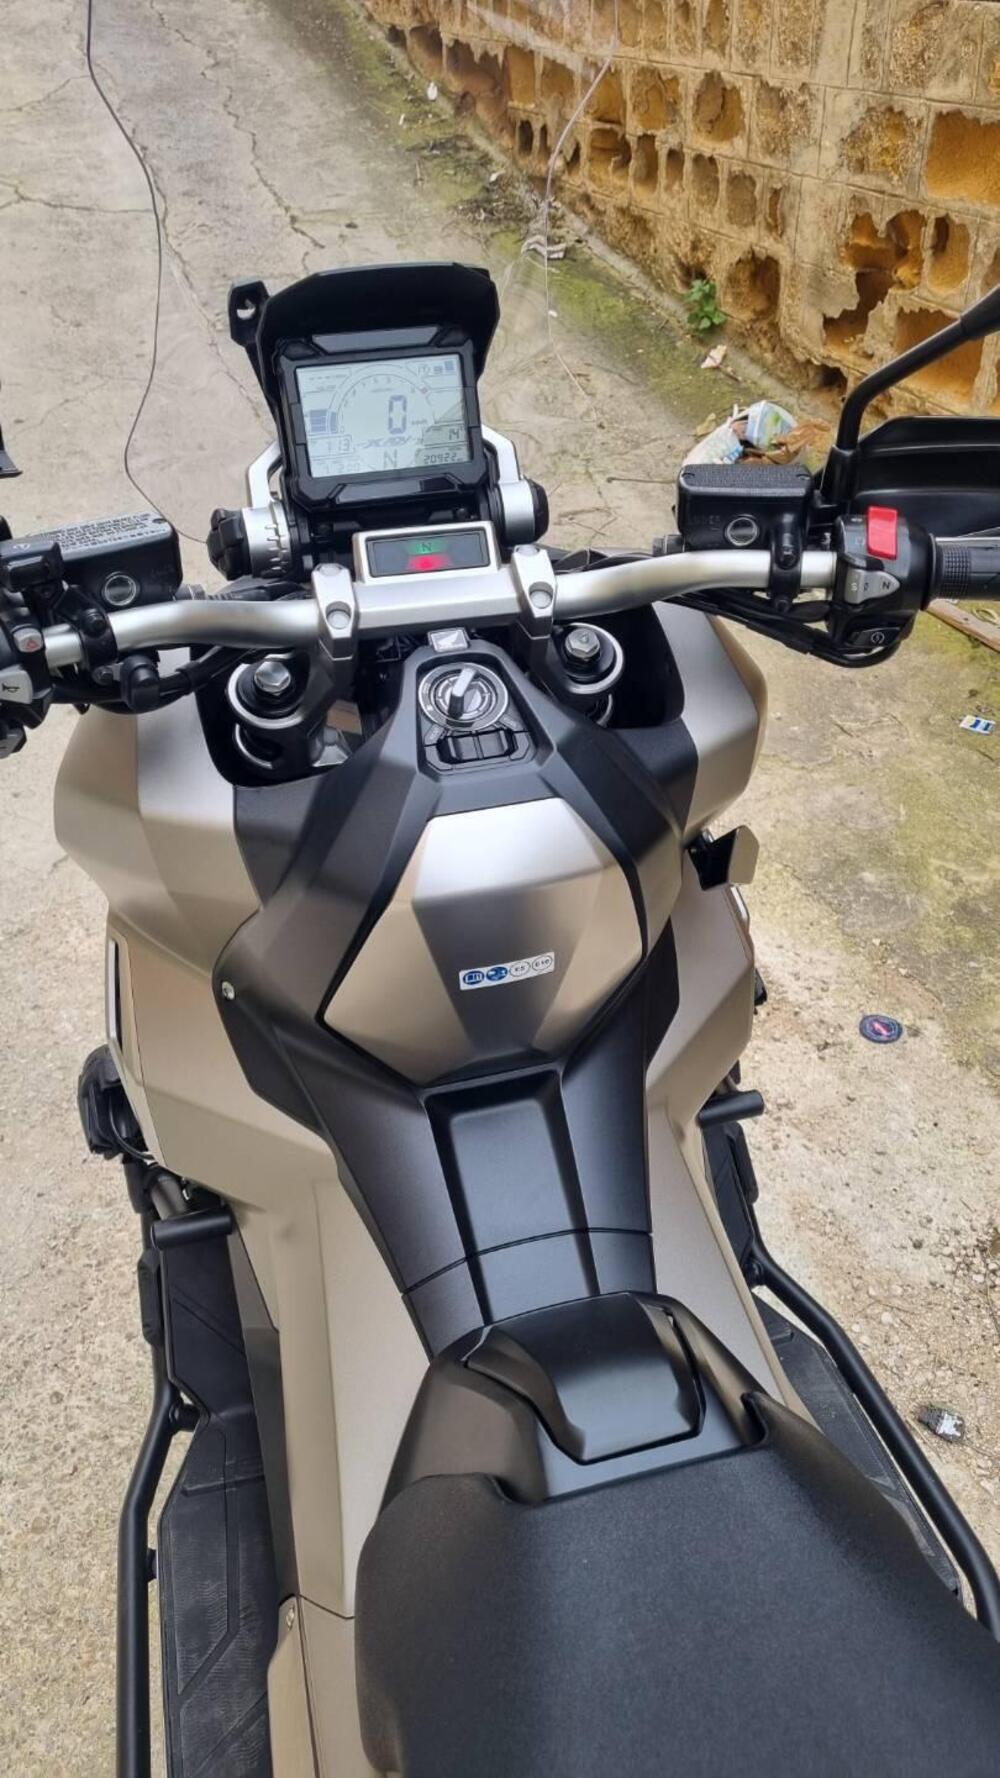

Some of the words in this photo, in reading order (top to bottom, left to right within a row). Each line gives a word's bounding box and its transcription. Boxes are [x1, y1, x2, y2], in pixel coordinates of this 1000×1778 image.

[388, 395, 407, 434] 0
[384, 450, 398, 468] N
[422, 542, 431, 552] N
[882, 581, 890, 590] N
